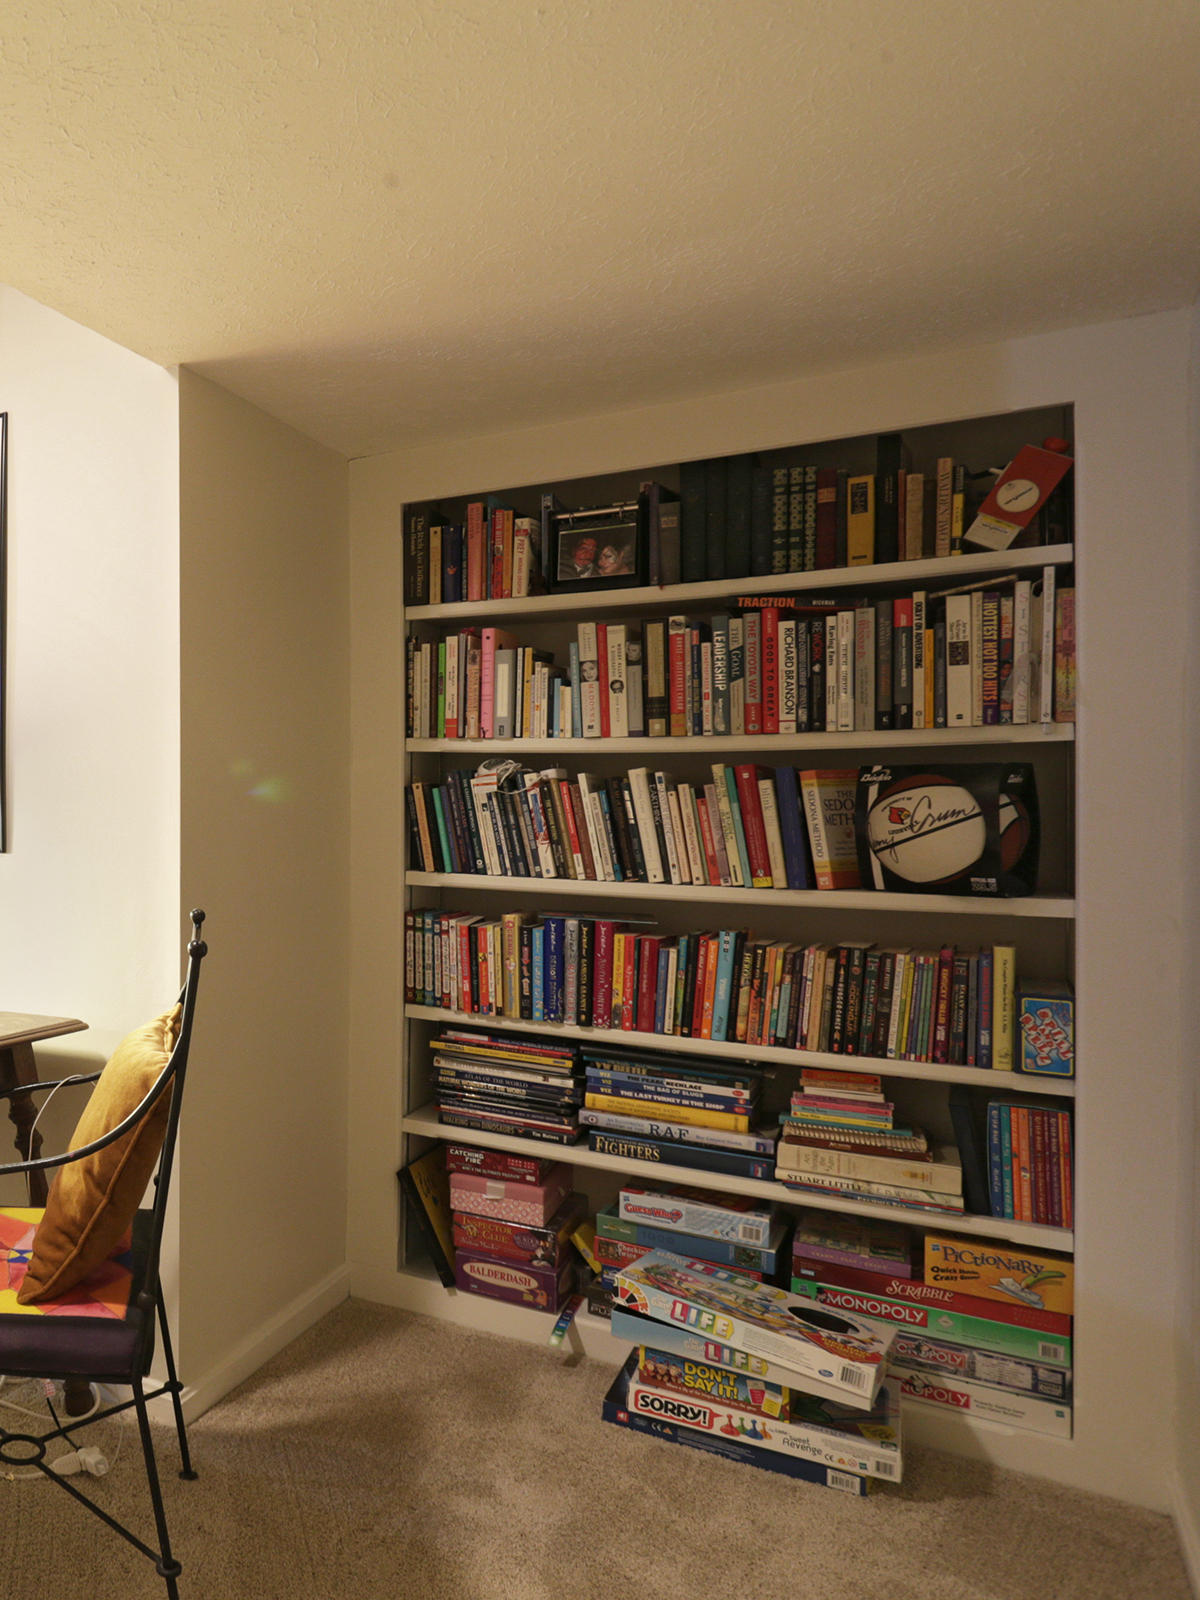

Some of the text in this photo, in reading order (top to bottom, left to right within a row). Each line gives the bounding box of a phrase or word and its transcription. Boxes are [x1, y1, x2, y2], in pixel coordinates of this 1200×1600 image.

[516, 538, 526, 554] PREY
[737, 597, 796, 608] TRACTION
[914, 601, 923, 622] OGILVY
[730, 628, 742, 678] THE GOAL
[812, 622, 824, 662] REWORK
[827, 625, 837, 666] Raving Fans
[914, 632, 923, 670] ADVERTISING
[983, 602, 998, 702] HOTTEST HOT 100 HITS
[713, 631, 728, 691] LEADERSHIP
[747, 620, 759, 700] THE TOYOTA WAY
[783, 627, 795, 715] RICHARD BRANSON
[766, 636, 776, 718] GOOD TO GREAT
[806, 791, 824, 858] SEDONA METHOD
[464, 1072, 482, 1081] ATLAS
[505, 1080, 528, 1089] WORLD
[666, 1081, 703, 1091] NECKLACE
[634, 1092, 653, 1100] LAST
[648, 1123, 689, 1140] RAF
[449, 1148, 485, 1160] CATCHING
[594, 1135, 661, 1162] FIGHTERS
[465, 1157, 482, 1165] FIRE
[787, 1173, 862, 1192] STUART LITTLE
[623, 1202, 683, 1223] Guess Who?
[462, 1216, 513, 1235] INSPECTOR
[469, 1264, 532, 1287] BALDERDASH
[930, 1266, 957, 1274] Quick
[885, 1280, 954, 1303] SCRABBLE
[827, 1291, 925, 1323] MONOPOLY
[674, 1302, 730, 1337] LIFE
[707, 1343, 763, 1373] LIFE
[683, 1361, 738, 1387] DON'T
[683, 1375, 715, 1394] SAY
[718, 1383, 738, 1401] IT!
[639, 1394, 708, 1425] SORRY!
[782, 1437, 823, 1456] Revenge
[788, 1435, 810, 1445] Sweet
